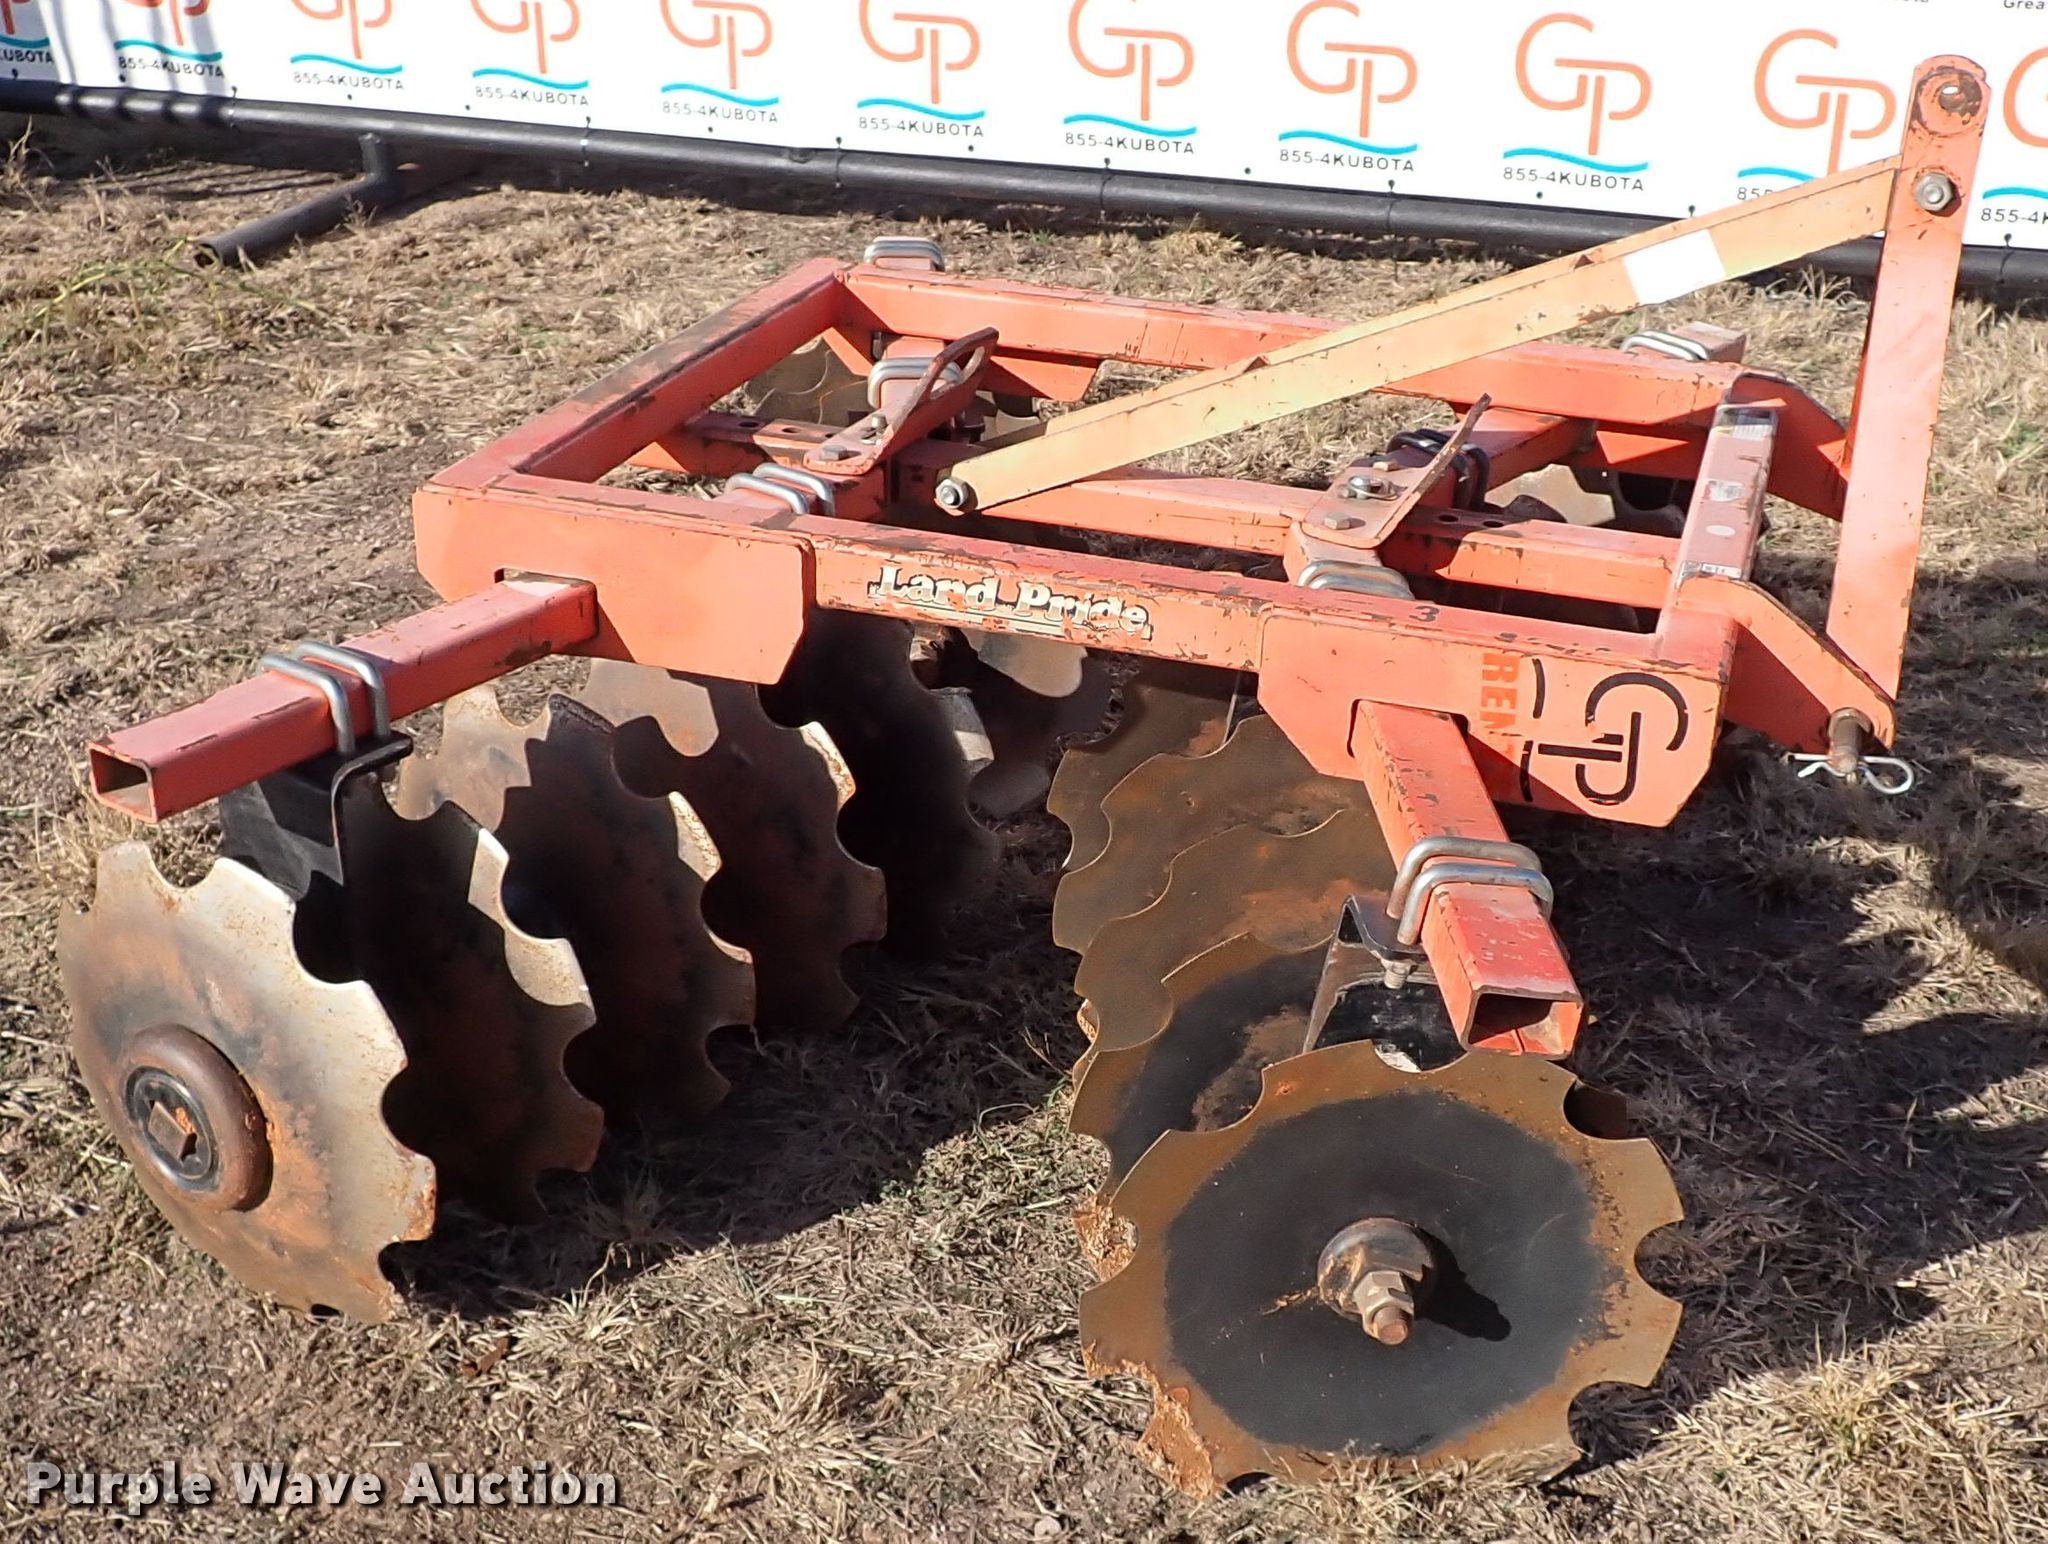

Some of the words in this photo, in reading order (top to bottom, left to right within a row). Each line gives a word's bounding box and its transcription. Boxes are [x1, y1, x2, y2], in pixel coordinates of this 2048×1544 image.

[0, 49, 55, 64] UBOTA
[859, 0, 981, 104] GP
[1068, 0, 1195, 121] GP
[118, 56, 225, 78] 855-4KUBOTA
[1287, 0, 1418, 138] GP
[293, 71, 405, 90] 855-4KUBOTA
[1515, 12, 1651, 156] GP
[475, 86, 589, 106] 855-4KUBOTA
[1754, 28, 1897, 176] GP
[662, 101, 778, 123] 855-4KUBOTA
[858, 116, 984, 137] 855-4KUBOTA
[1065, 132, 1194, 154] 855-4KUBOTA
[1279, 149, 1414, 172] 855-4KUBOTA
[1503, 167, 1644, 191] 855-4KUBOTA
[871, 566, 999, 611] Land
[1014, 581, 1151, 635] Pride
[1480, 652, 1520, 760] REN
